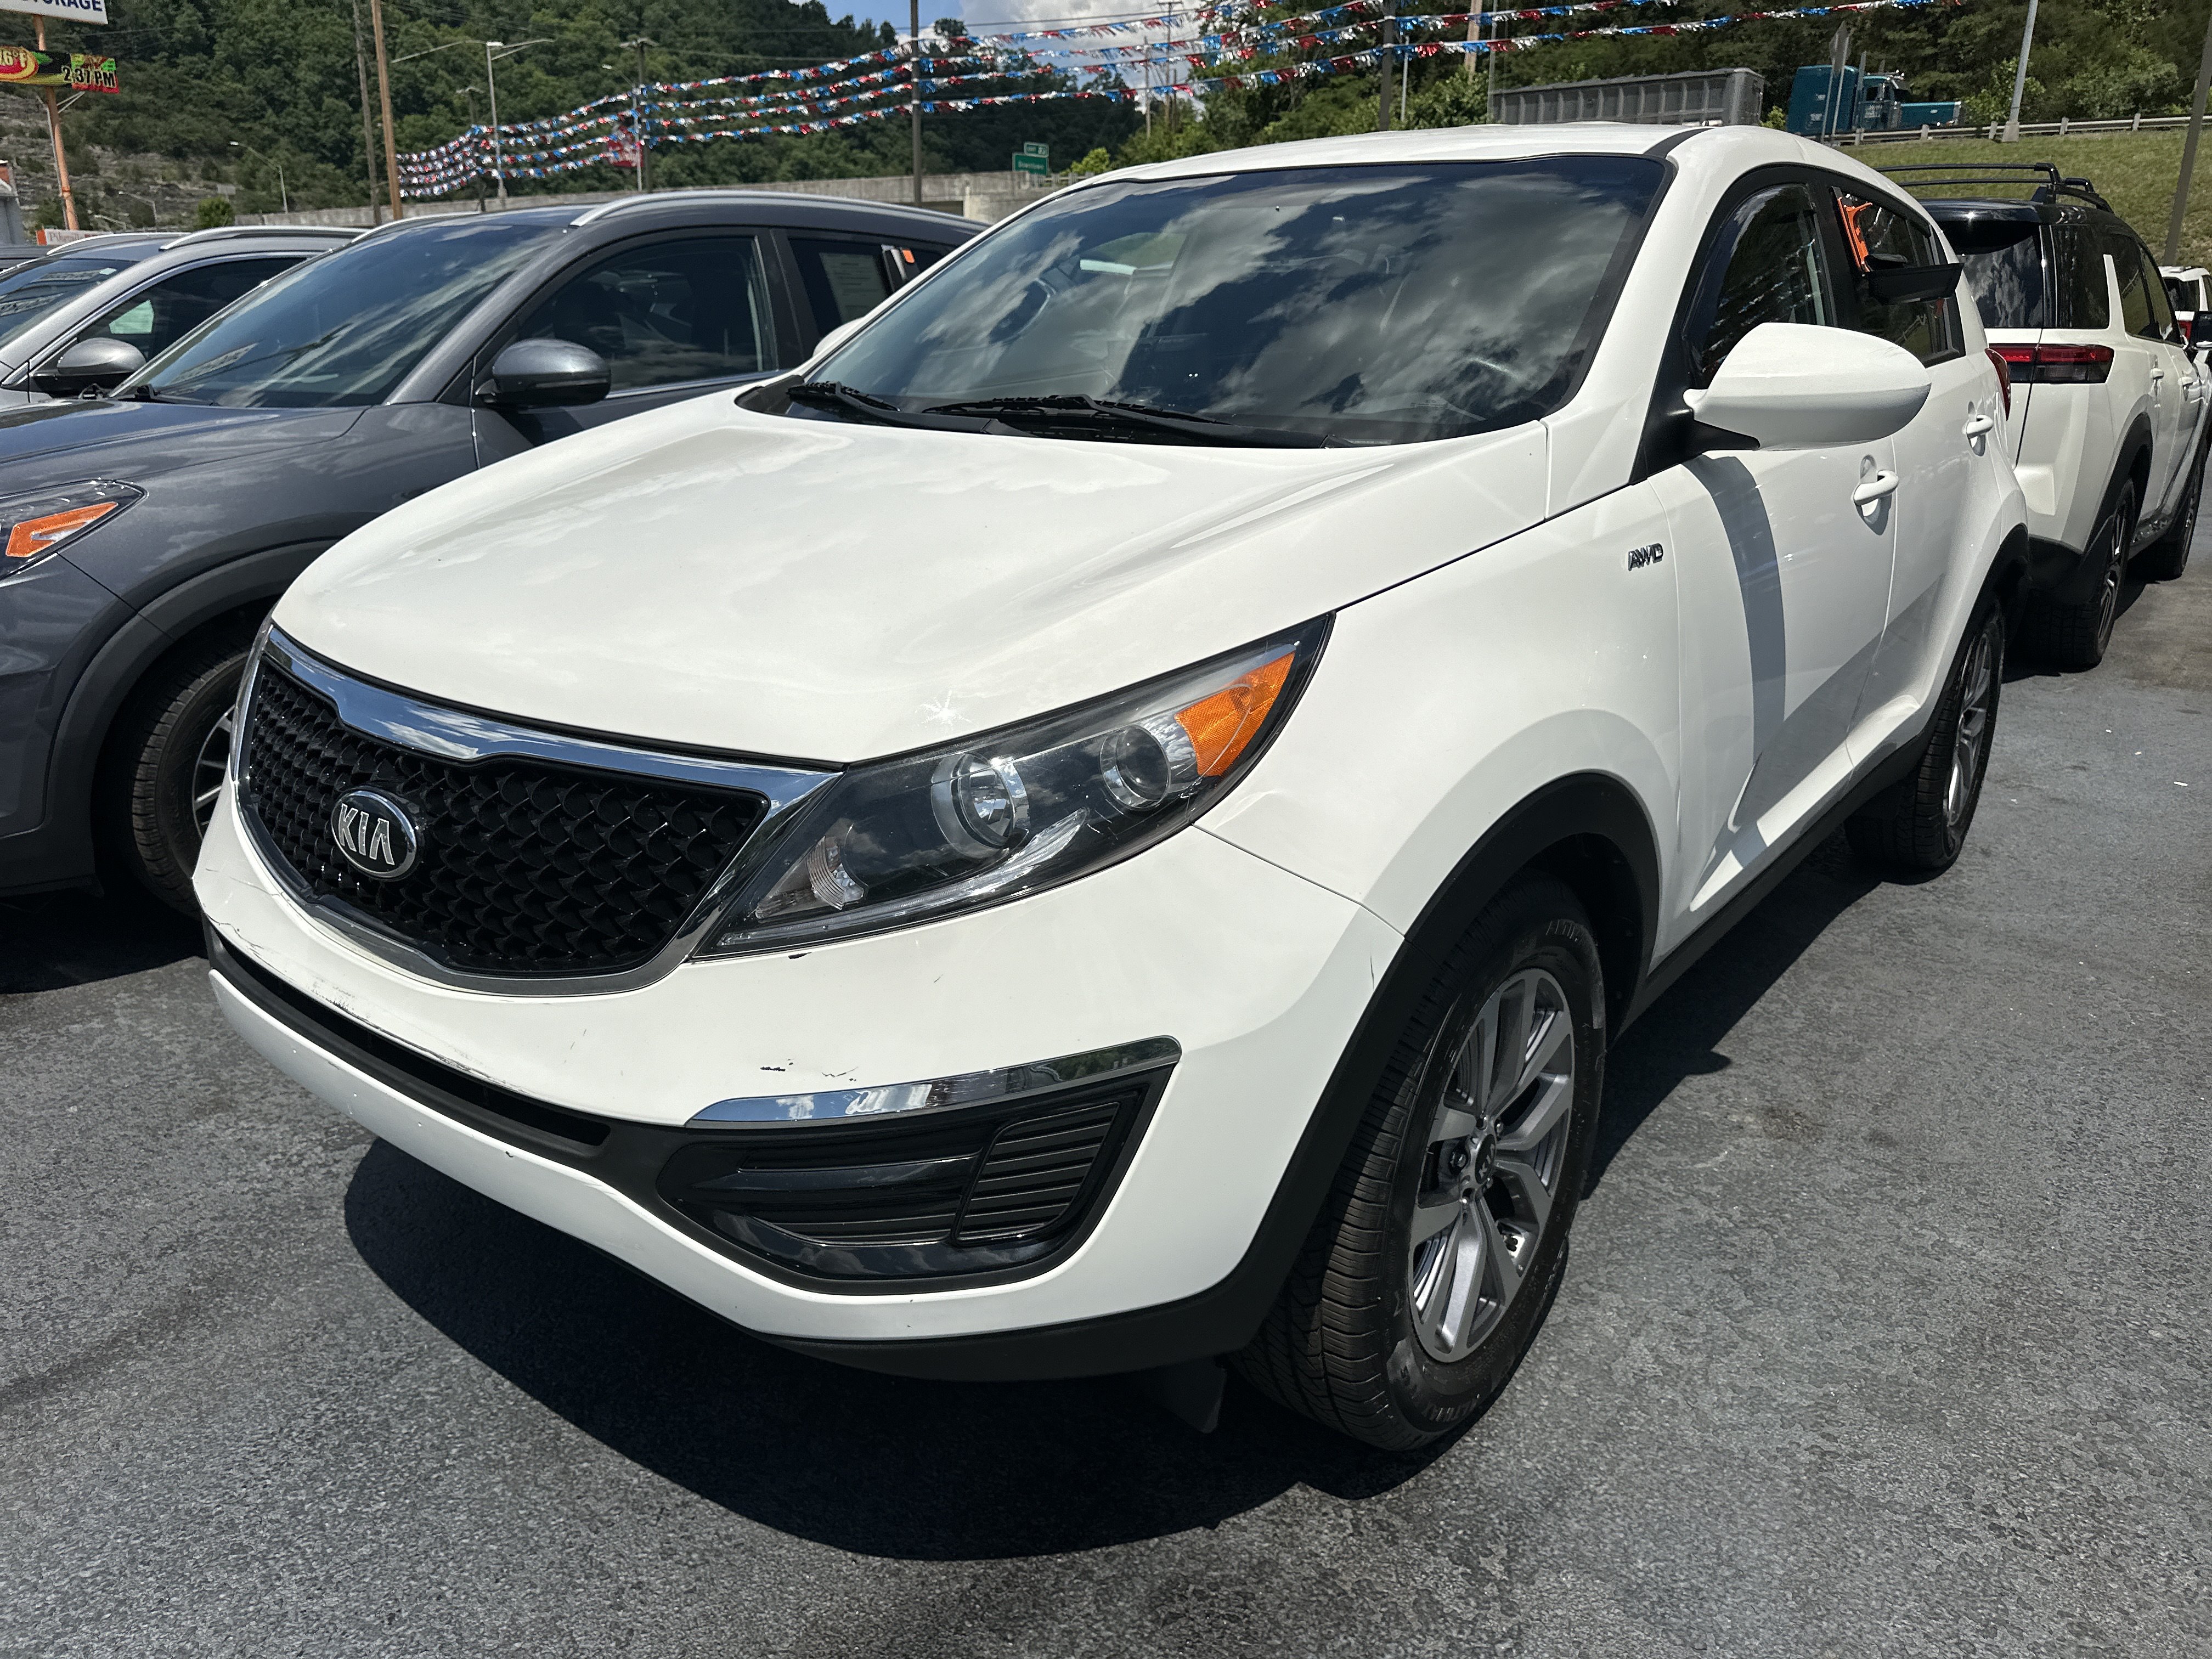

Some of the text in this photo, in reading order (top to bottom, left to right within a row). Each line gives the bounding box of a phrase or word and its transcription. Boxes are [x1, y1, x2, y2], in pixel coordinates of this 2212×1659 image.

[94, 69, 117, 88] PM
[1628, 543, 1664, 572] AWD
[338, 803, 395, 866] KIA
[1479, 1143, 1495, 1177] KIA
